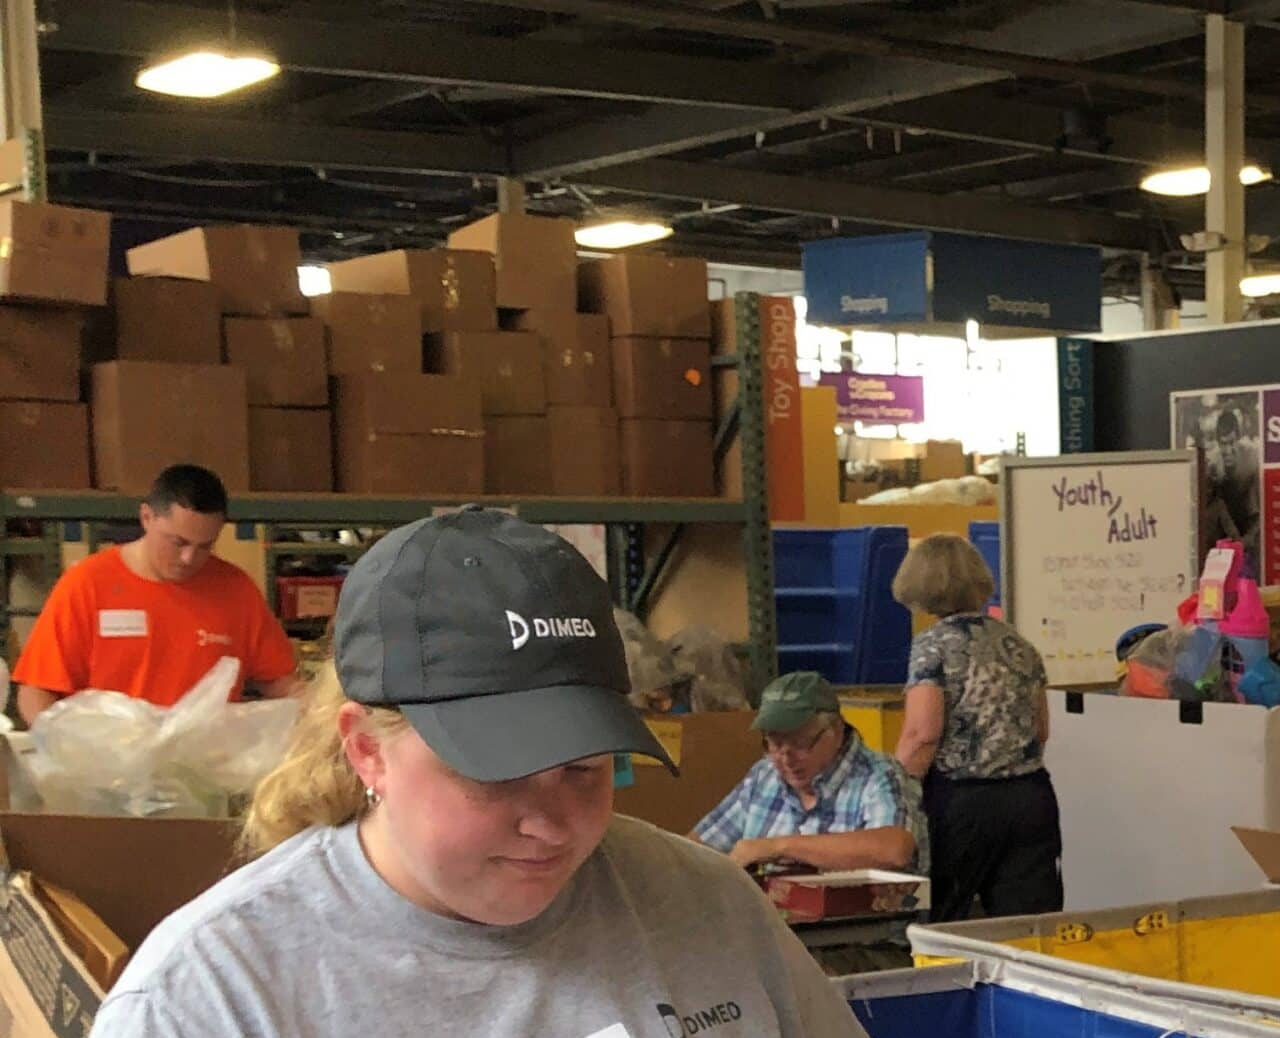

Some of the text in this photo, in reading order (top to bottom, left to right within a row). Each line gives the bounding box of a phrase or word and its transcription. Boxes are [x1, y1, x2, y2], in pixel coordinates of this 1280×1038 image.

[766, 303, 795, 424] Toy Shop
[1108, 508, 1157, 543] Adult
[533, 618, 596, 638] DIMEO
[683, 1001, 742, 1035] DIMEO
